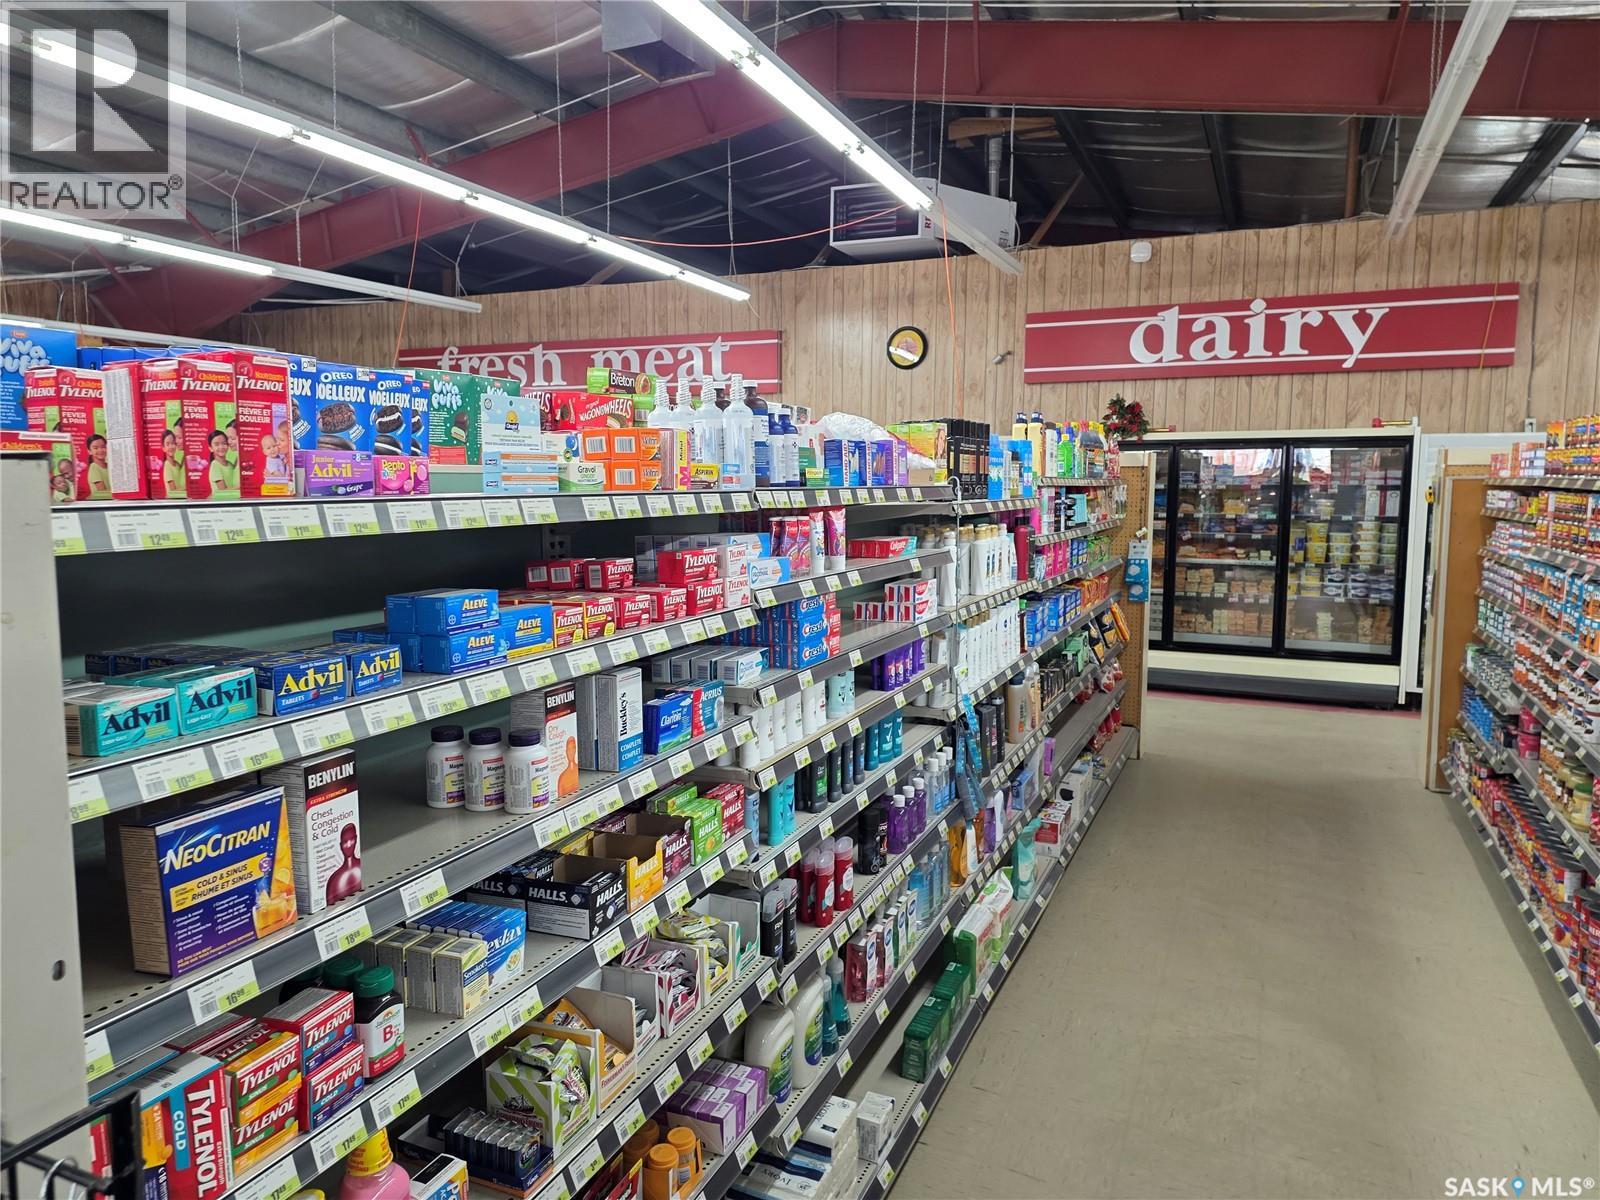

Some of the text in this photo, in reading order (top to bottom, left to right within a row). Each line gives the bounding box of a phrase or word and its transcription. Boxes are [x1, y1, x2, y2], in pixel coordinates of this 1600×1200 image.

[1129, 299, 1389, 368] dairy
[437, 336, 731, 387] fresh meat
[181, 378, 231, 392] TYLENOL
[236, 375, 284, 391] TYLENOL
[321, 372, 353, 382] OREO
[378, 380, 401, 389] OREO
[611, 373, 635, 387] Breton
[59, 385, 104, 398] TYLENO
[141, 379, 178, 393] TYLENOL
[62, 411, 87, 419] FEVER
[184, 406, 208, 414] FEVER
[310, 463, 352, 478] Advil
[577, 465, 597, 475] Gravol
[684, 554, 717, 569] TYLENOL
[696, 584, 723, 600] TYLENOL
[462, 598, 488, 611] ALEVE
[625, 600, 650, 613] TYLENOL
[663, 595, 686, 606] TYLENOL
[800, 598, 820, 612] Crest
[587, 602, 613, 617] TYLENOL
[516, 618, 542, 630] ALEVE
[556, 613, 583, 627] TYLENOL
[803, 621, 823, 636] Crest
[468, 634, 495, 649] ALEVE
[803, 645, 823, 660] Crest
[356, 651, 400, 679] Advil
[278, 662, 344, 697] Advil
[187, 678, 254, 714] Advil
[282, 695, 305, 706] TABLETS
[546, 690, 574, 708] BENYLIN
[102, 701, 171, 736] Advil
[621, 748, 641, 762] COMPLET
[308, 762, 355, 790] BENYLIN
[311, 807, 333, 822] Chest
[724, 800, 742, 819] HALLS
[311, 809, 354, 832] Congestion
[698, 818, 719, 839] HALLS
[312, 824, 340, 841] & Cold
[665, 834, 688, 858] HALLS
[196, 863, 248, 889] COLD & SINUS
[191, 871, 254, 902] RHUME ET SINUS
[596, 880, 623, 907] HALLS
[528, 887, 567, 903] HALLS
[306, 1007, 352, 1048] TYLENOL
[312, 1036, 330, 1052] COLD
[240, 1051, 298, 1097] TYLENOL
[313, 1059, 362, 1103] TYLENOL
[320, 1089, 339, 1106] COLD
[235, 1097, 295, 1145] TYLENOL
[173, 1110, 186, 1151] COLD
[187, 1079, 218, 1198] TYLENOL
[762, 1168, 791, 1185] IVORY
